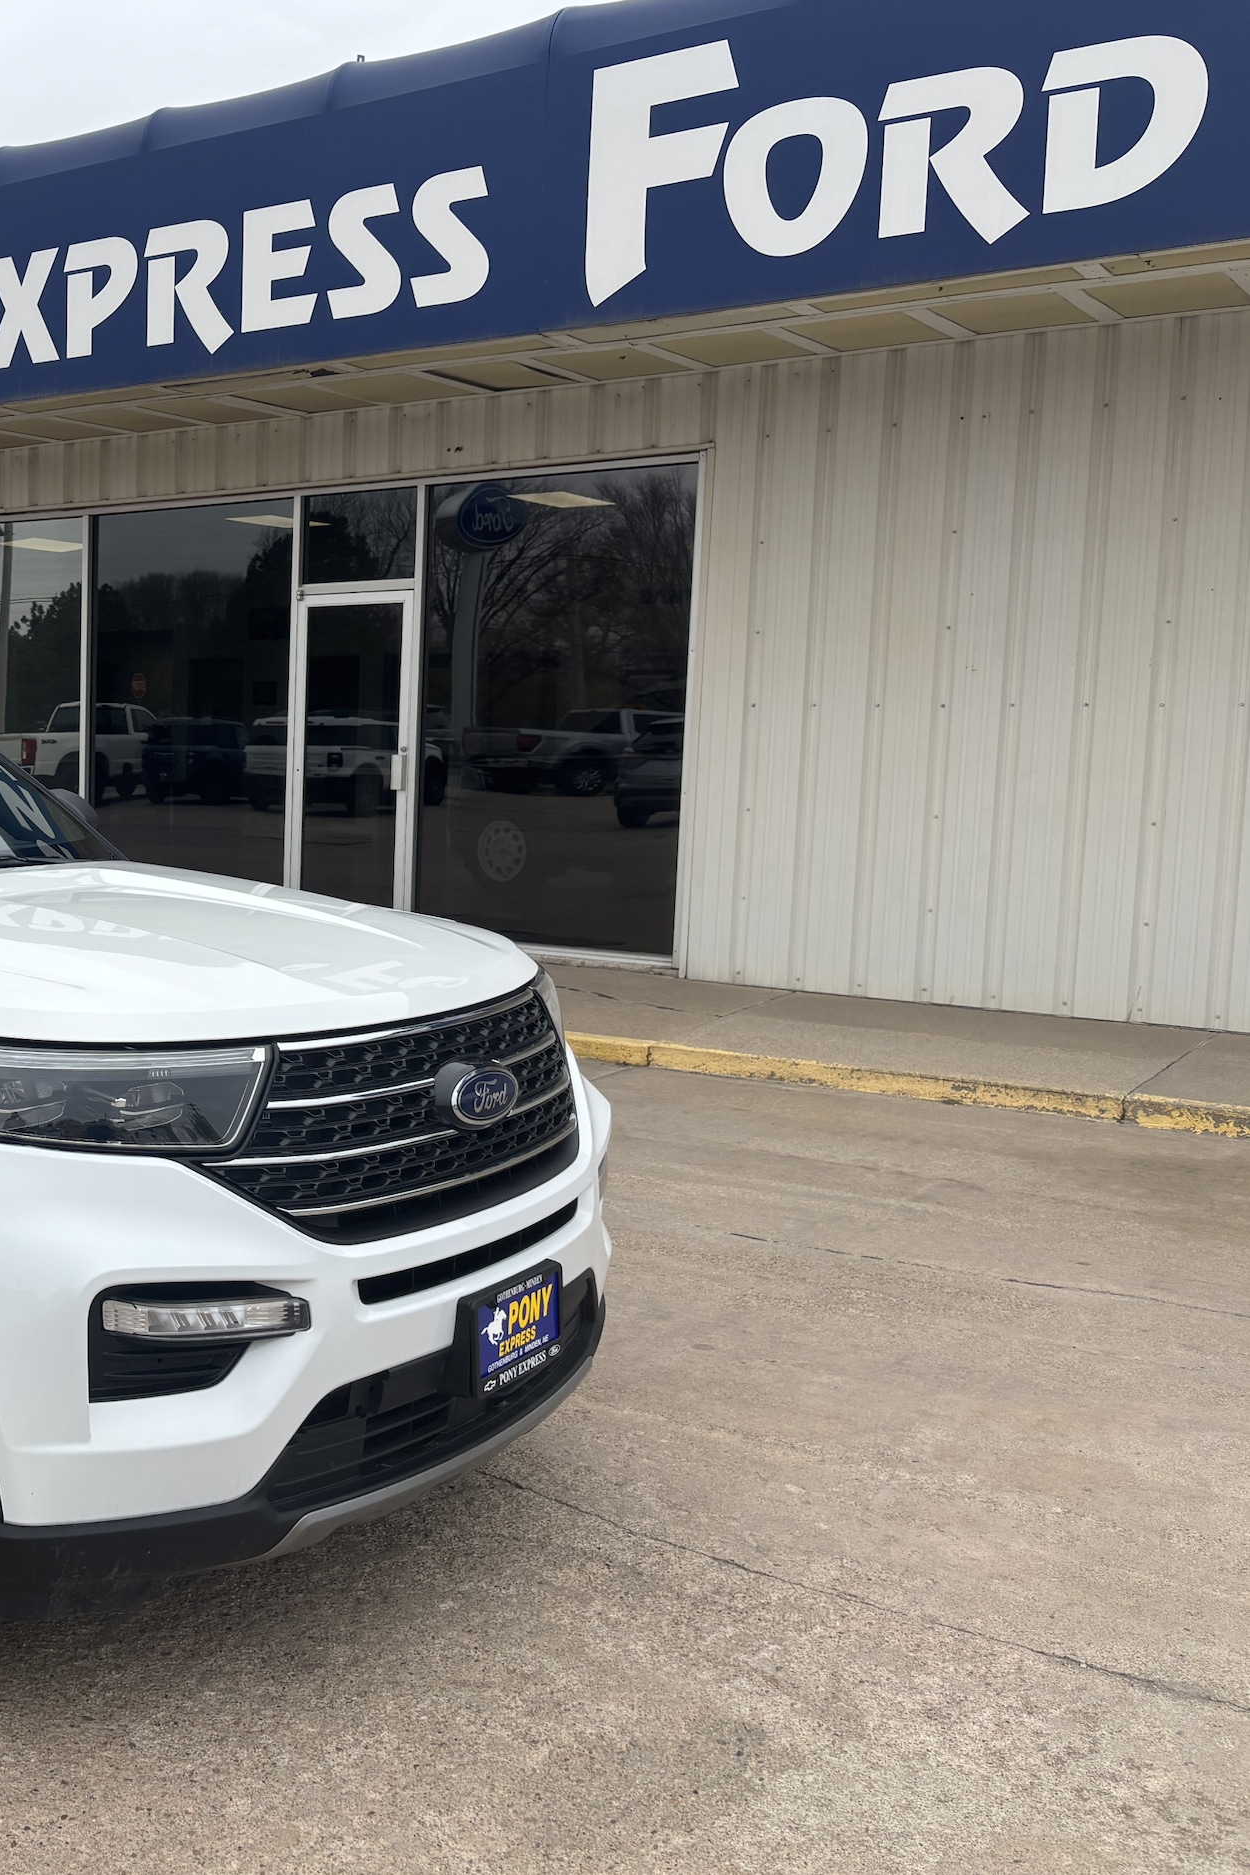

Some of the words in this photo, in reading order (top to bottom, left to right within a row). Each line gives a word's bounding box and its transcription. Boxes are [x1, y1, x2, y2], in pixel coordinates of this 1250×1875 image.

[583, 34, 1210, 308] FORD
[473, 1078, 509, 1114] Ford
[507, 1283, 554, 1336] PONY
[498, 1325, 537, 1358] EXPRESS
[487, 1350, 519, 1374] GOTHENBURG
[499, 1365, 518, 1386] PONY
[518, 1349, 547, 1376] EXPRESS
